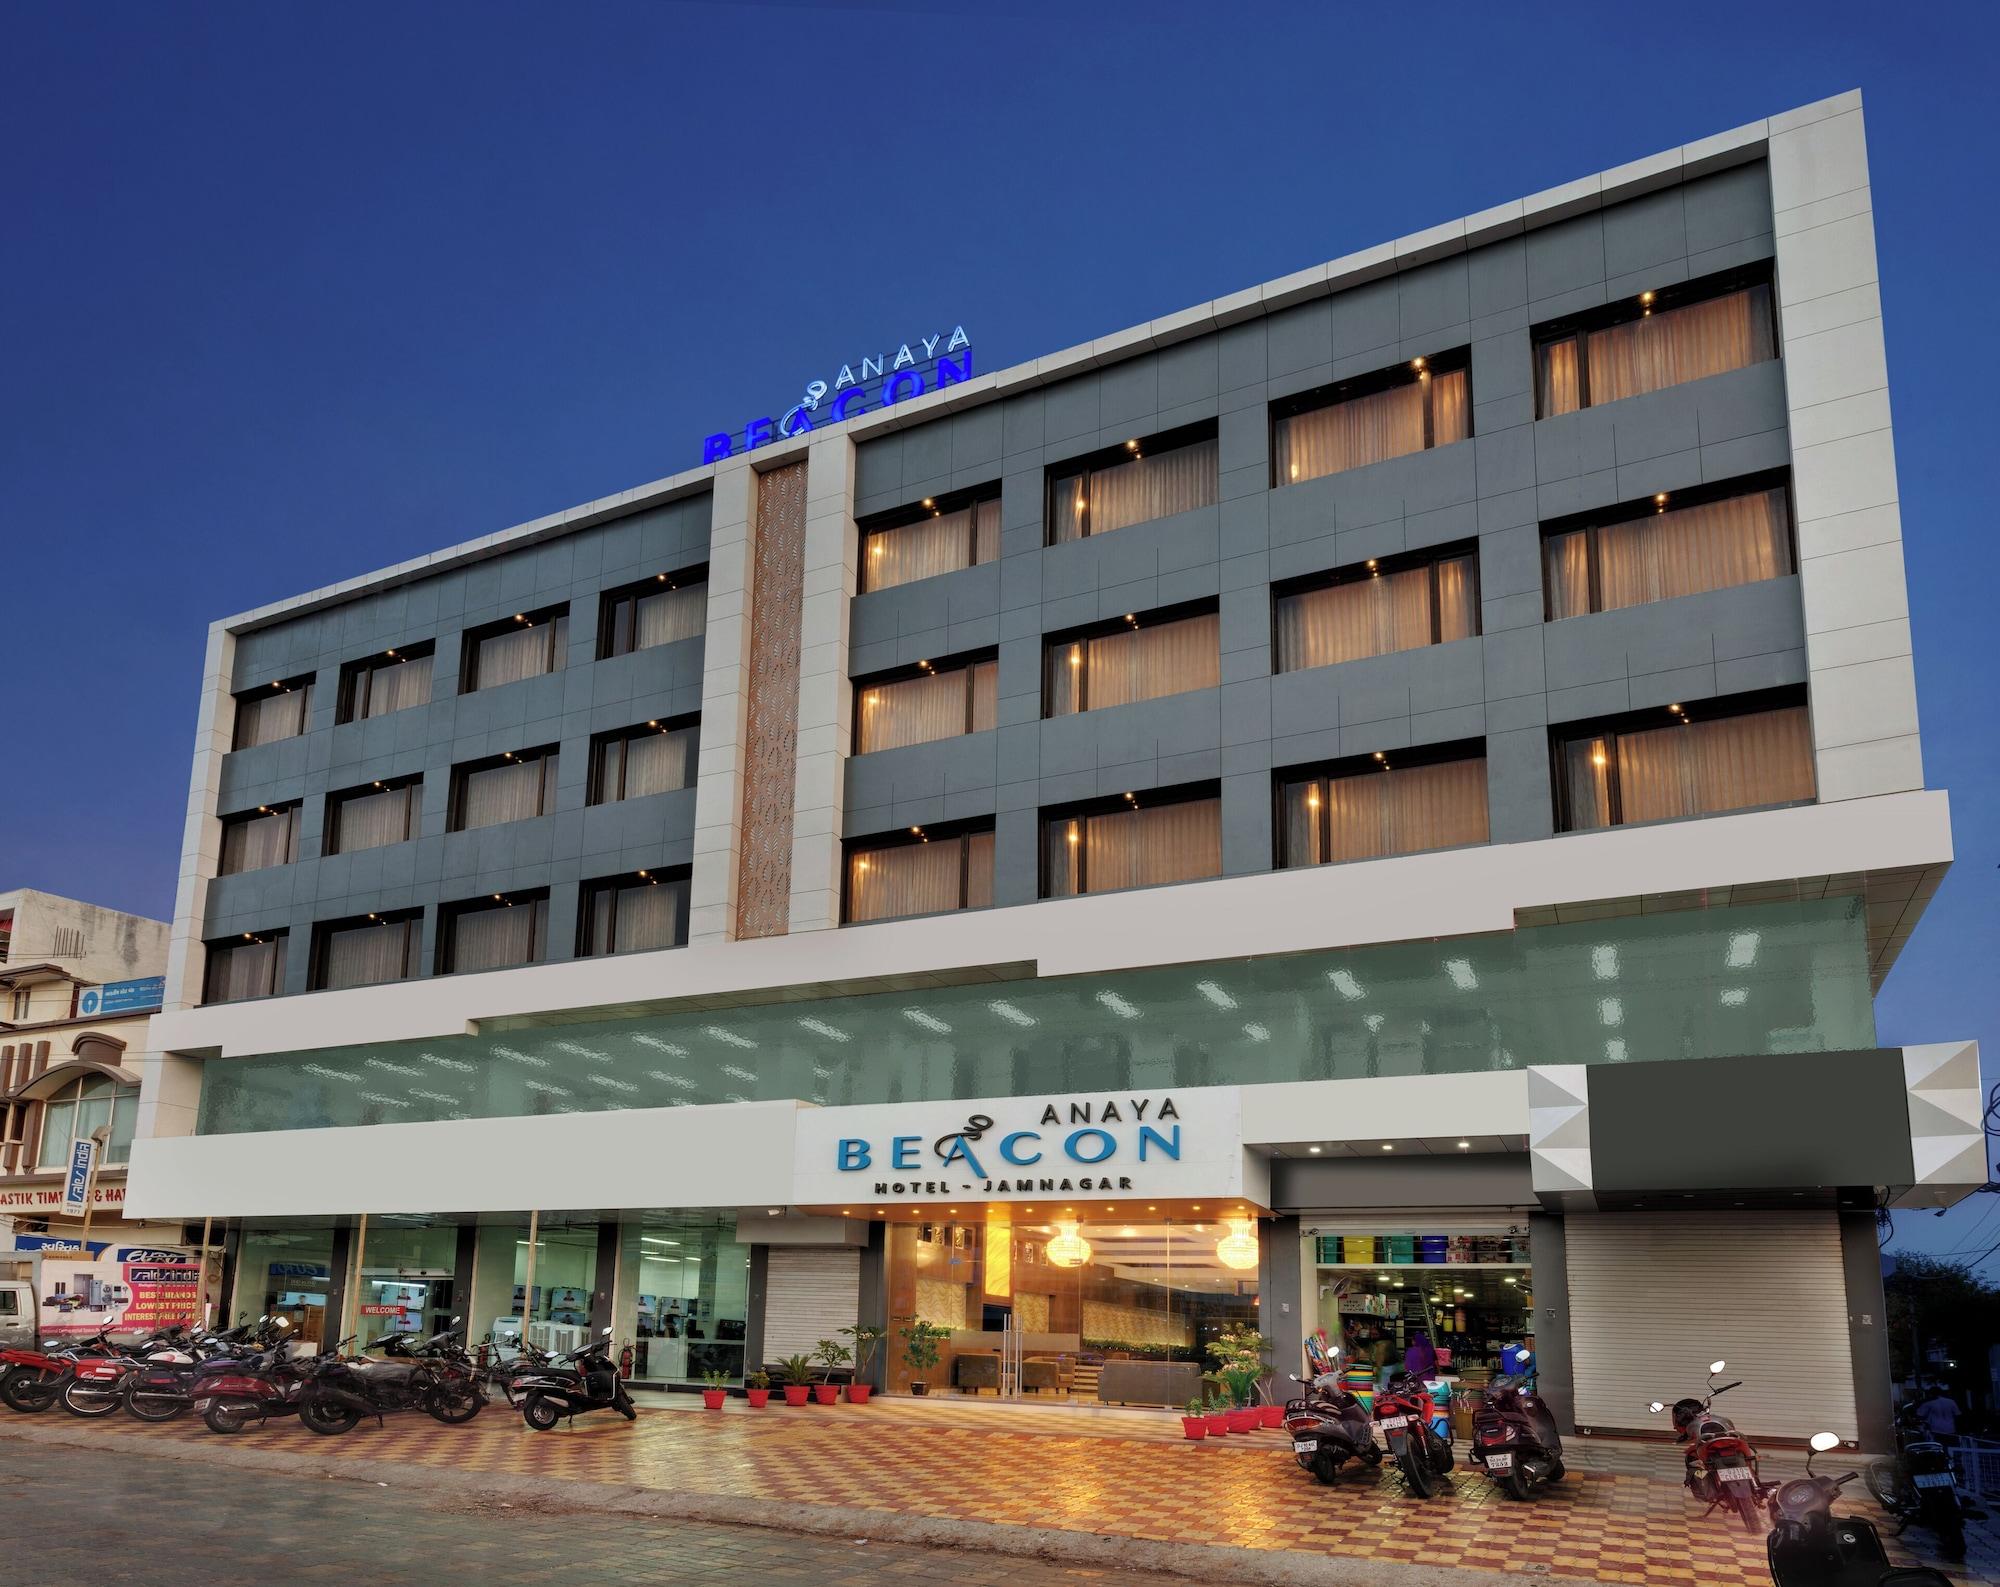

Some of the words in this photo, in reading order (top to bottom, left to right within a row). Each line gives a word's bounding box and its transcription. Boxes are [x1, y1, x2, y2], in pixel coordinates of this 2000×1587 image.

[835, 325, 970, 389] ANAYA
[703, 350, 972, 465] BEACON
[1040, 1097, 1179, 1125] ANAYA
[837, 1125, 1181, 1179] BEACON
[874, 1181, 950, 1194] HOTEL
[983, 1176, 1133, 1192] JAMNAGAR
[365, 1306, 401, 1314] WELCOME
